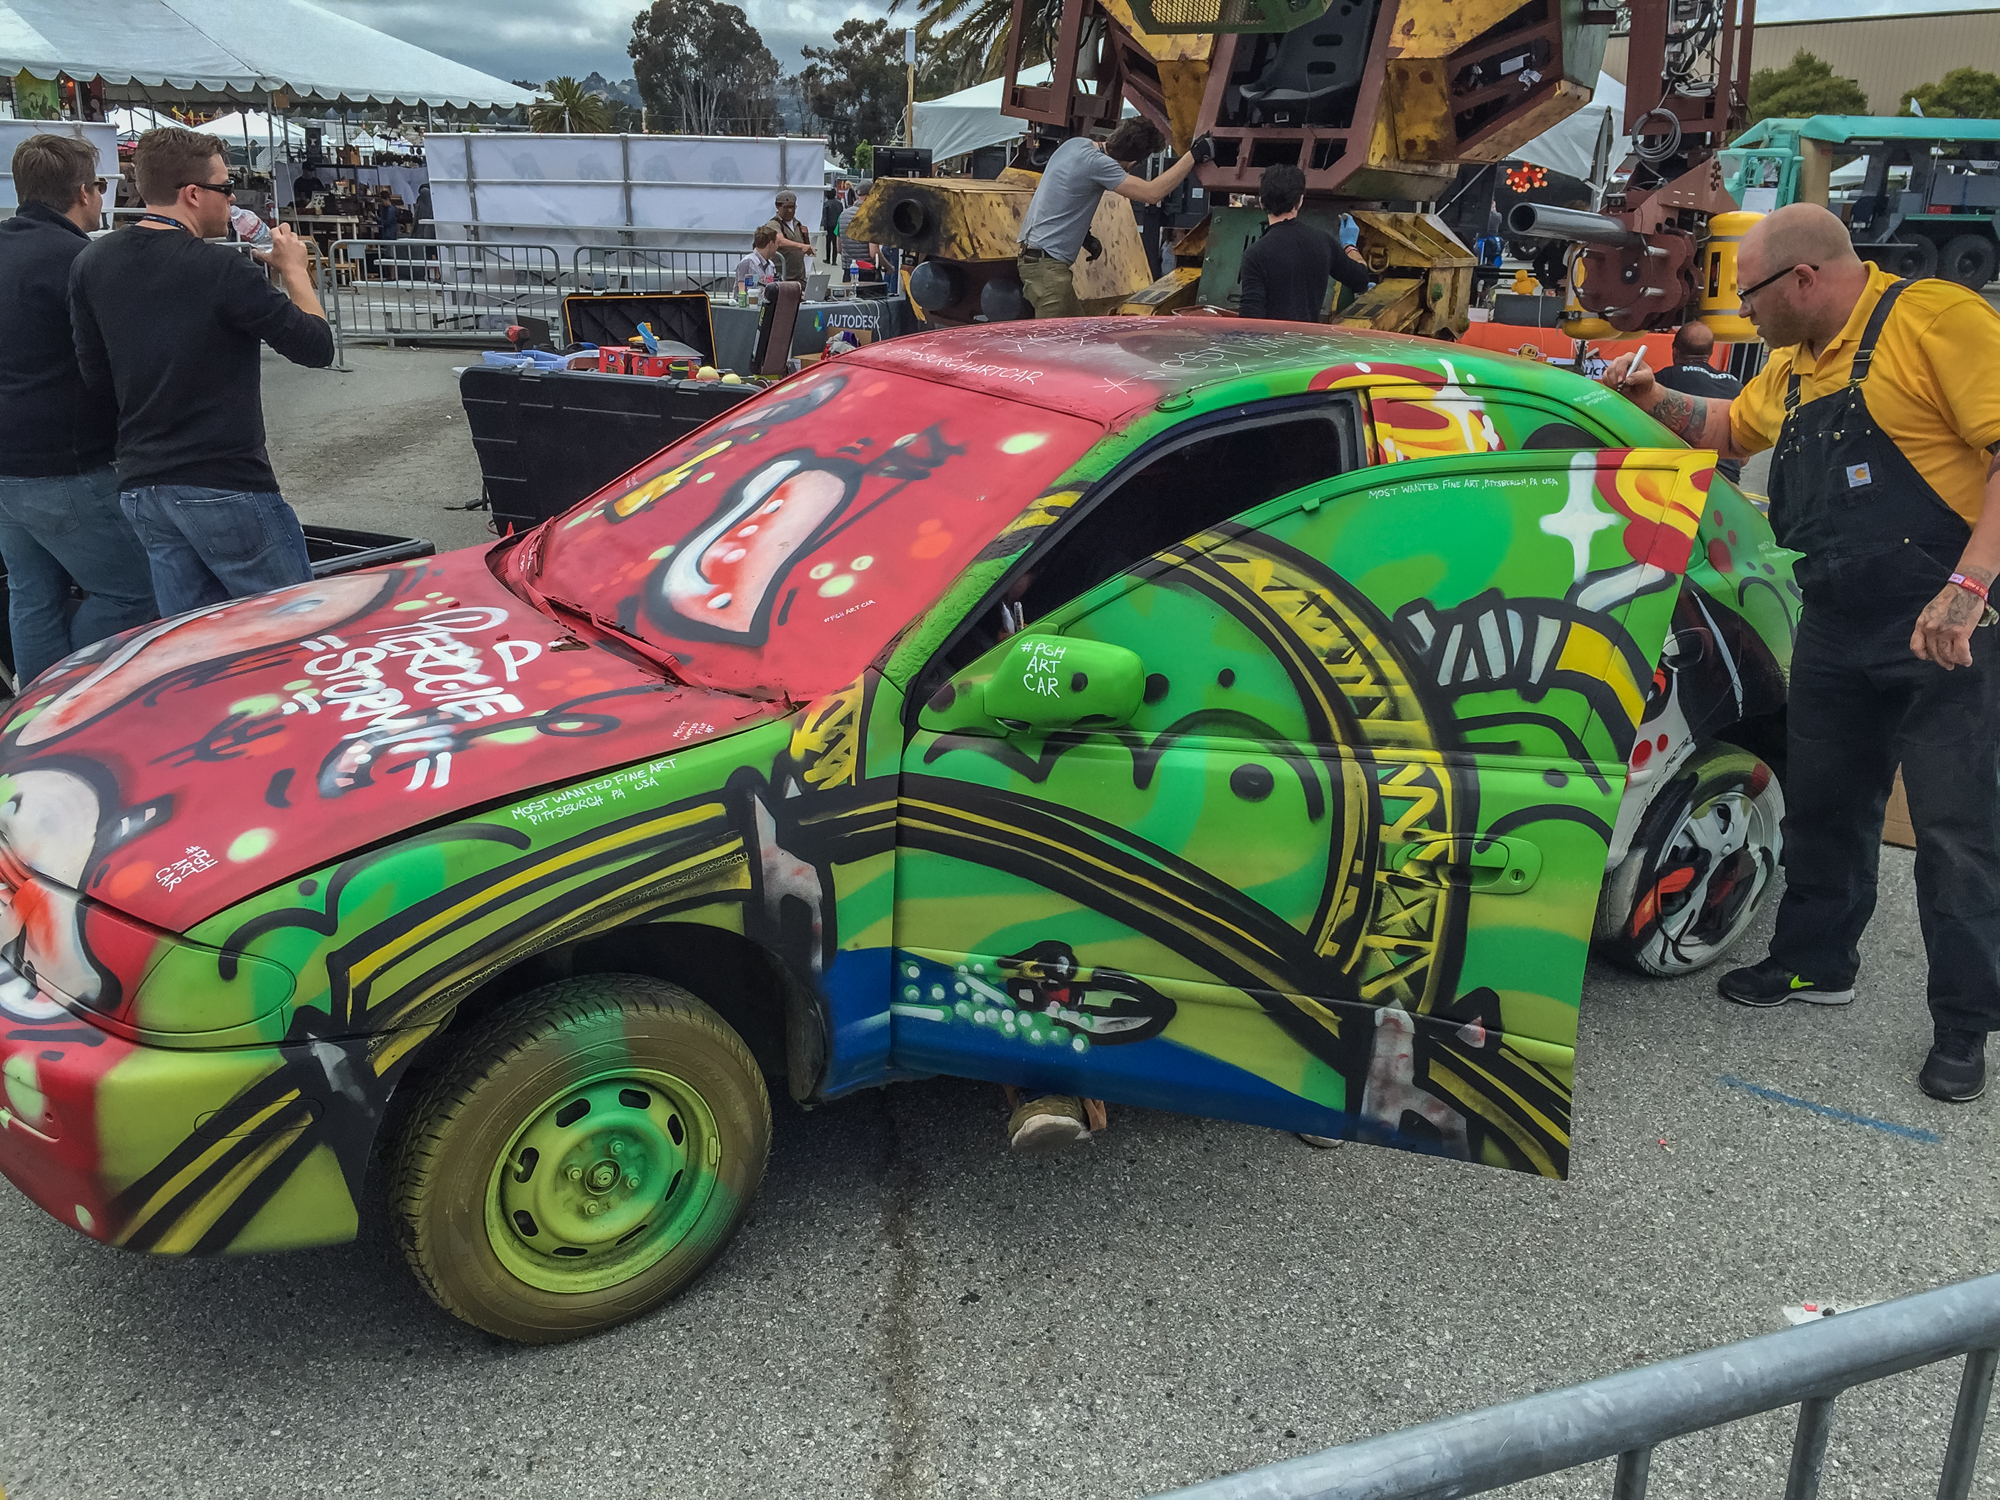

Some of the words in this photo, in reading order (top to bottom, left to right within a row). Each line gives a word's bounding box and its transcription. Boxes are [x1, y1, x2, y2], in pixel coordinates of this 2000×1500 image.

[827, 314, 880, 329] AUTODESK
[1368, 487, 1398, 500] MOST
[1400, 482, 1439, 494] WANTED
[1442, 479, 1461, 490] FINE
[1541, 478, 1559, 487] USA
[845, 604, 860, 615] ART
[860, 599, 876, 608] CAR
[1020, 641, 1067, 660] #PGH
[1026, 655, 1061, 674] ART
[1023, 673, 1060, 699] CAR
[511, 798, 549, 820] MOST
[552, 779, 612, 803] WANTED
[615, 770, 648, 786] FINE
[649, 758, 677, 775] ART
[528, 795, 604, 826] PITTSBURGH
[611, 789, 626, 800] PA
[634, 777, 660, 791] USA
[171, 858, 199, 879] ART
[185, 845, 218, 873] #PGH
[155, 867, 182, 893] CAR
